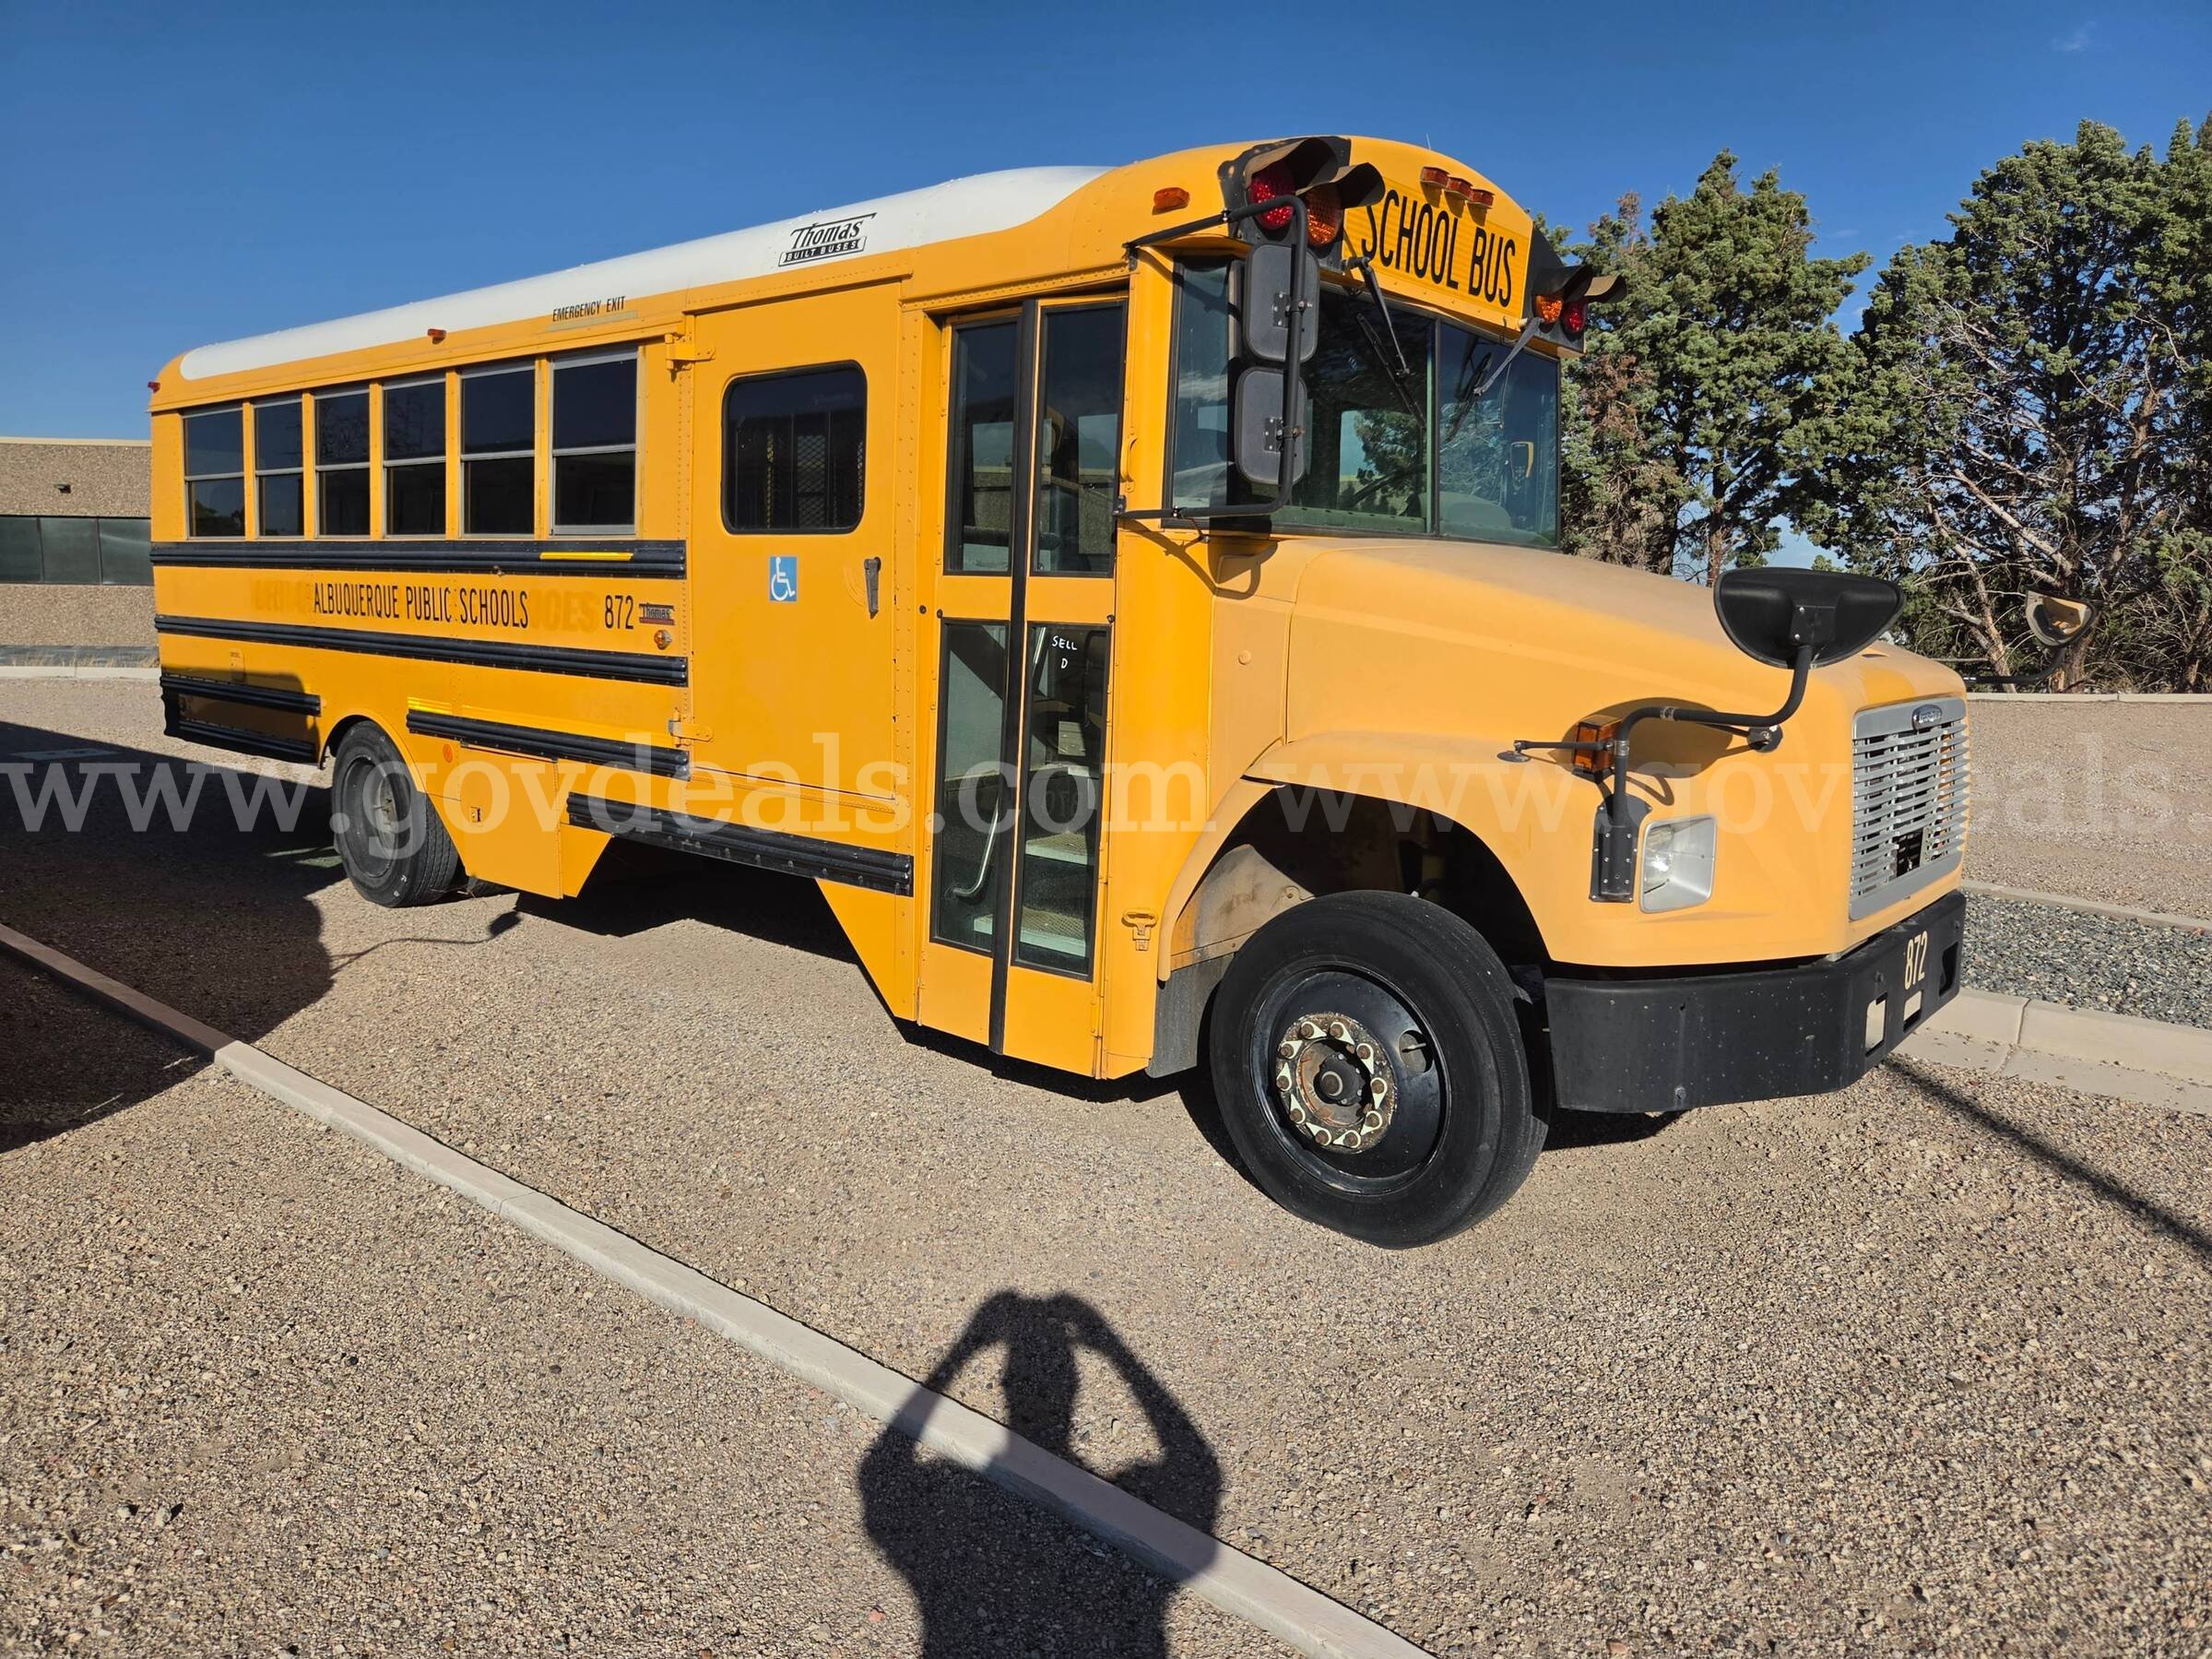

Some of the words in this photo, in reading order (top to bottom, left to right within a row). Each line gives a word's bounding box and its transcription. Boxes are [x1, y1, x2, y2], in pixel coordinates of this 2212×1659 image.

[790, 212, 877, 250] Thomas
[1360, 189, 1460, 290] SCHOOL
[1468, 227, 1516, 307] BUS
[786, 248, 816, 262] BUILT
[820, 240, 858, 255] BUSES
[552, 300, 601, 322] EMERGENCY
[606, 295, 626, 313] EXIT
[313, 583, 399, 619] ALBUQUERQUE
[406, 587, 452, 623] PUBLIC
[459, 588, 528, 629] SCHOOLS
[604, 595, 634, 630] 872
[1052, 635, 1077, 651] SELL
[1904, 930, 1928, 990] 872
